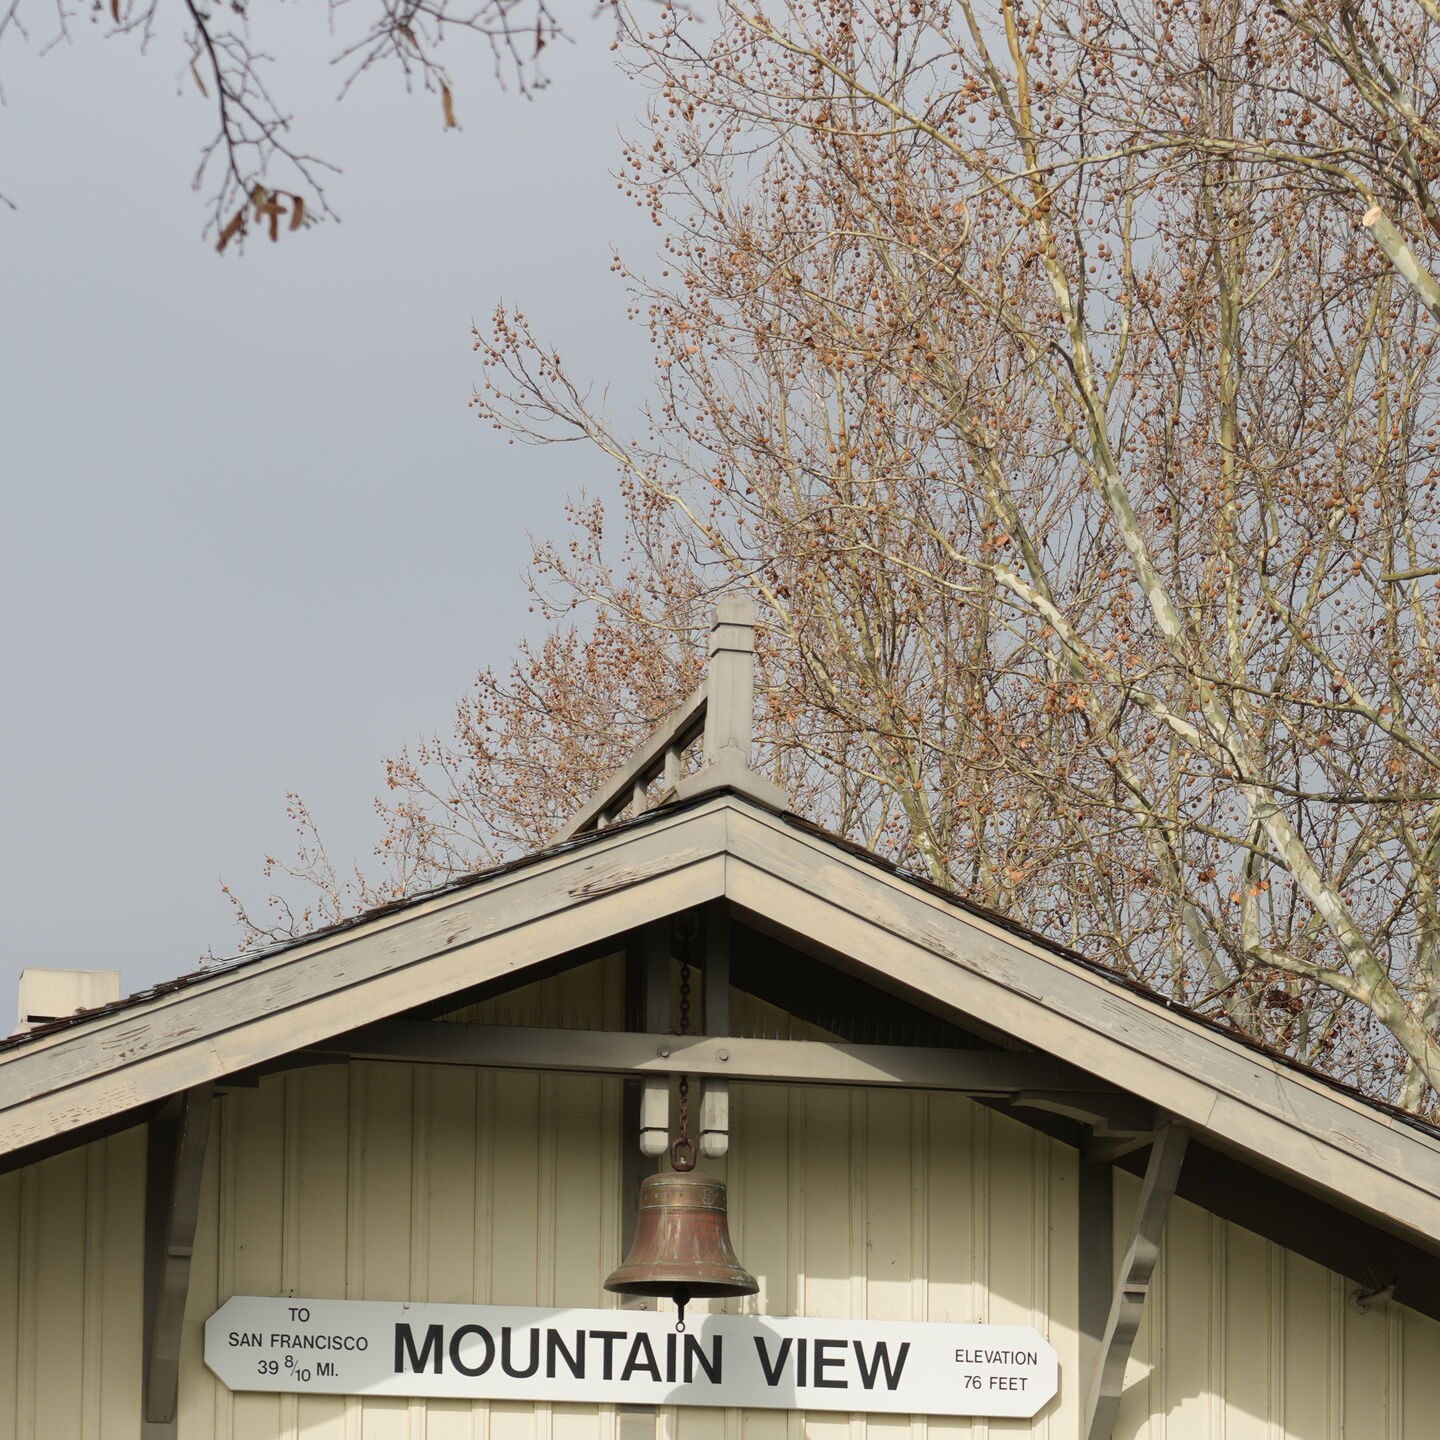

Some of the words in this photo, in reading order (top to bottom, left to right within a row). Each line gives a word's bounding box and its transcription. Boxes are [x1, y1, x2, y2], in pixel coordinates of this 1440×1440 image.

[288, 1307, 311, 1323] TO
[228, 1331, 263, 1348] SAN
[270, 1333, 369, 1351] FRANCISCO
[393, 1322, 724, 1385] MOUNTAIN
[752, 1335, 911, 1391] VIEW
[955, 1348, 1038, 1366] ELEVATION
[257, 1360, 279, 1375] 39
[316, 1362, 339, 1377] MI.
[963, 1375, 982, 1390] 76
[989, 1376, 1029, 1391] FEET
